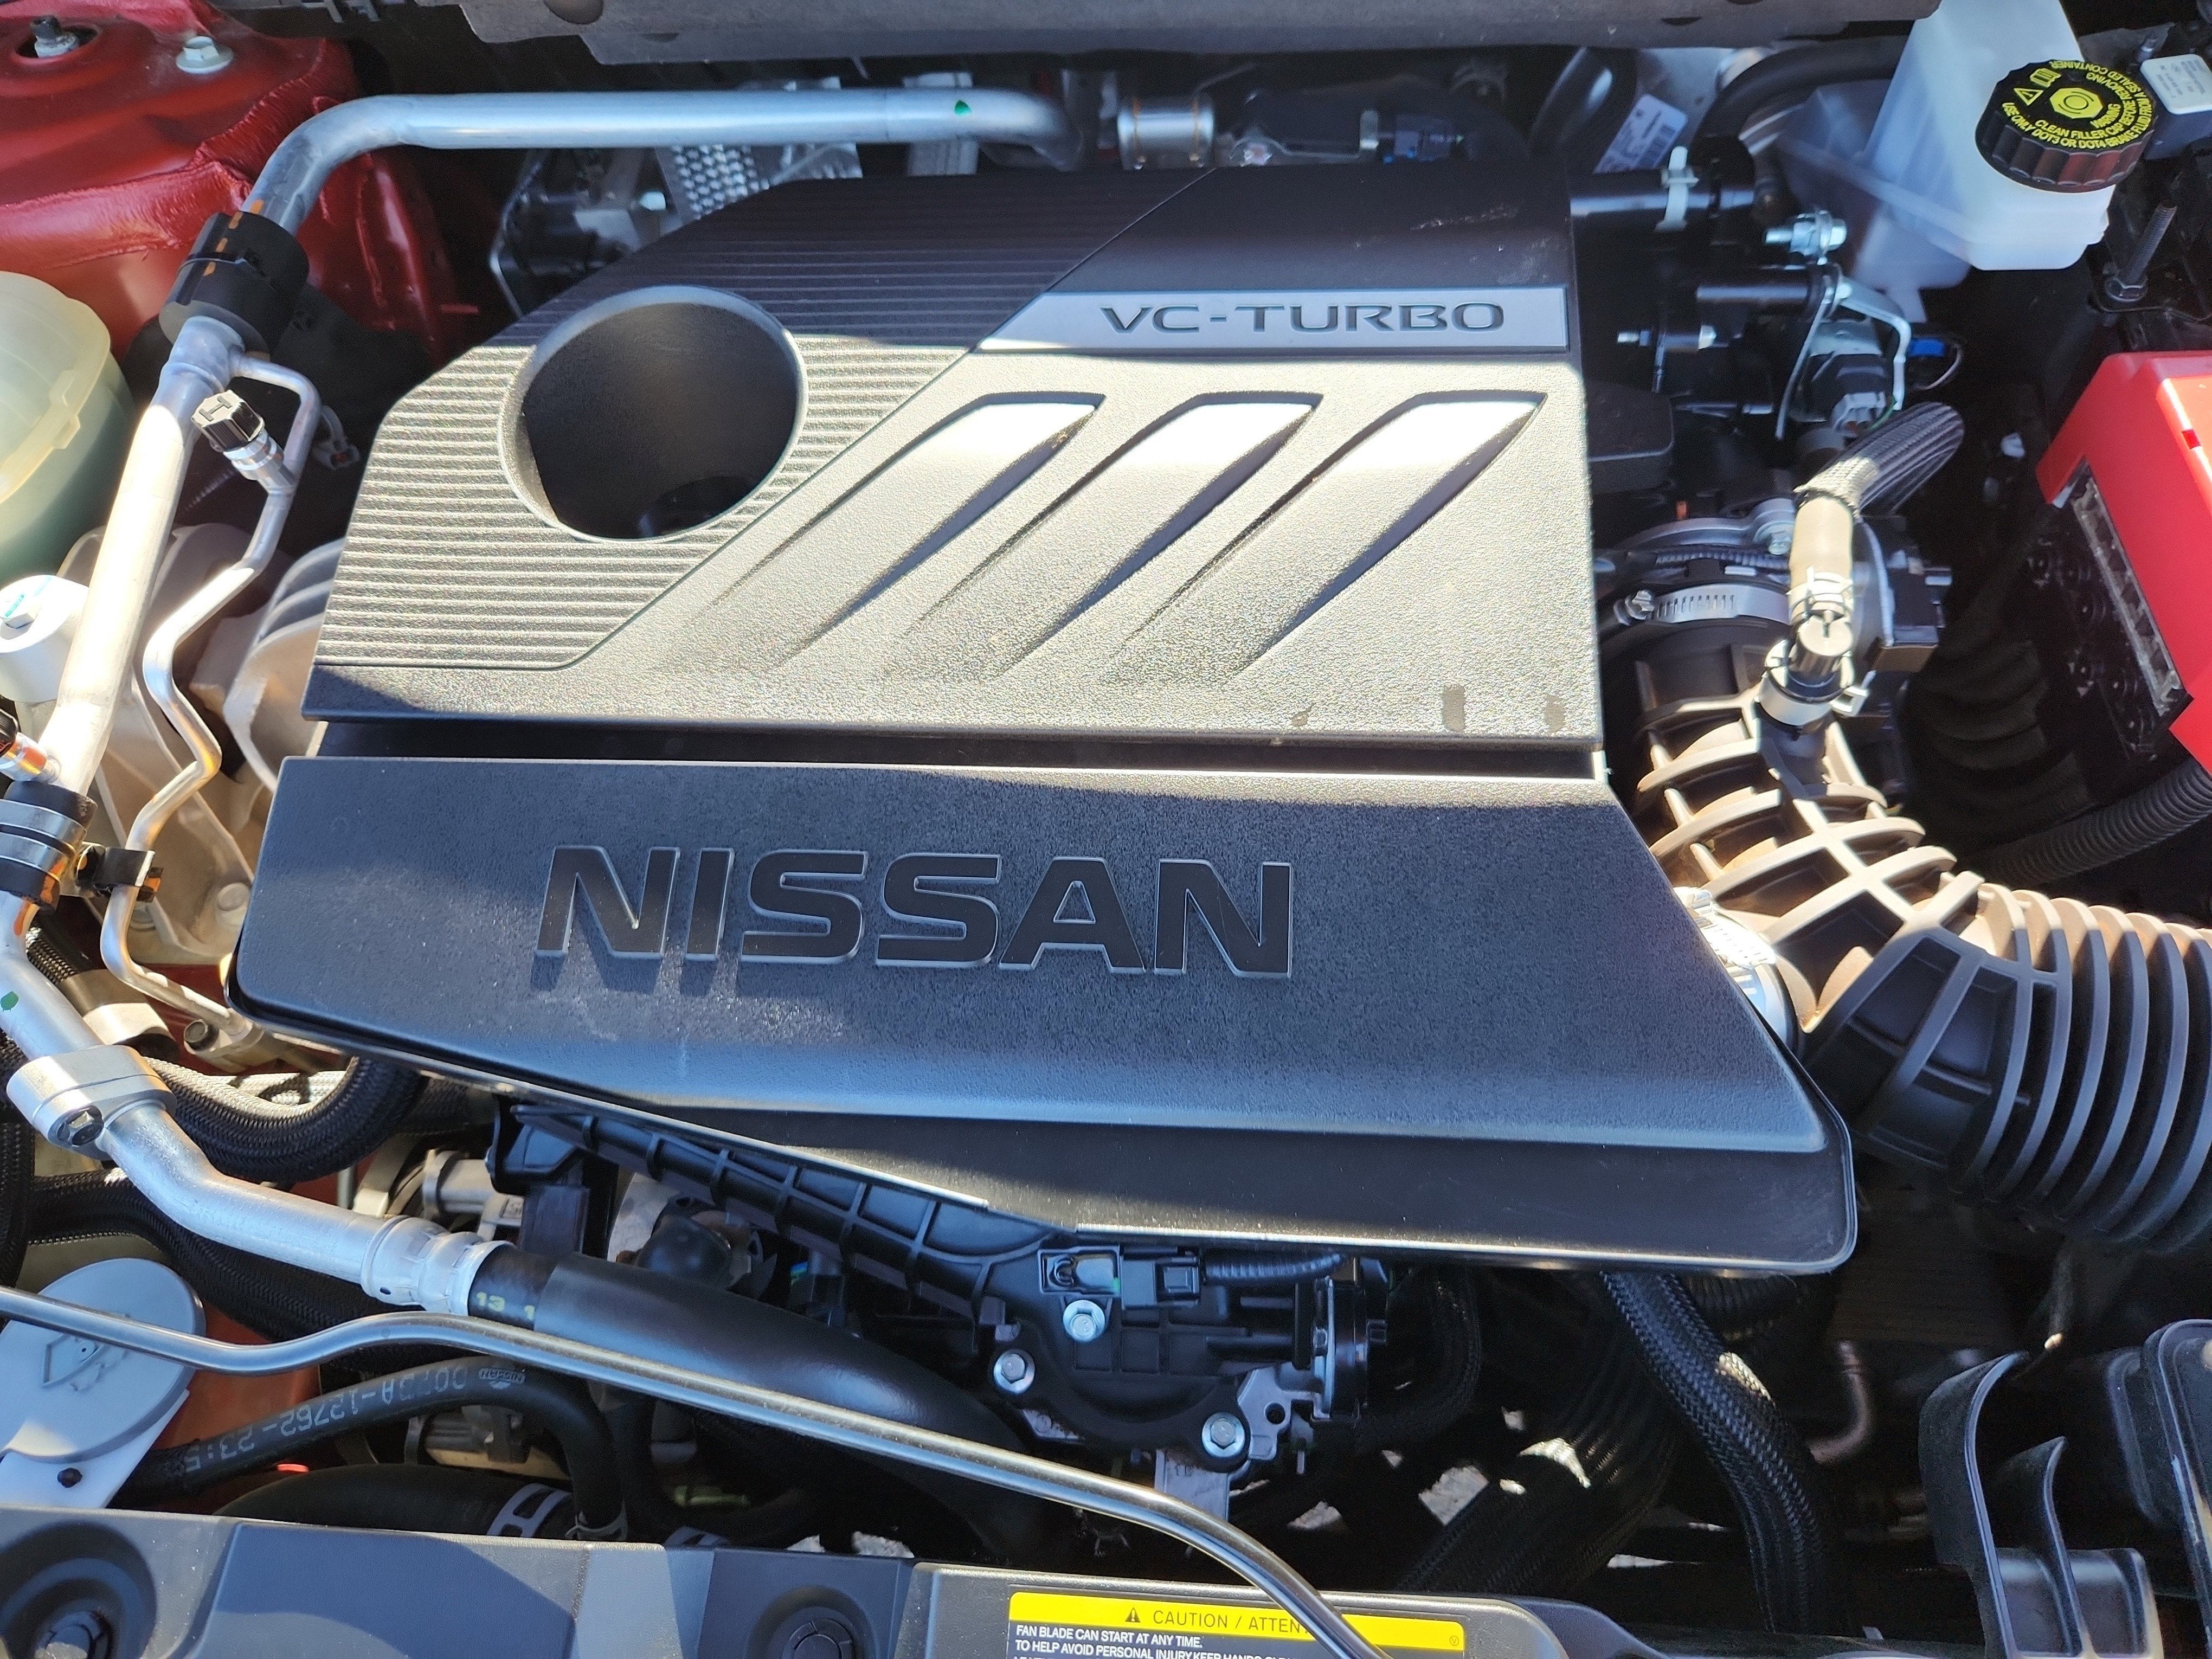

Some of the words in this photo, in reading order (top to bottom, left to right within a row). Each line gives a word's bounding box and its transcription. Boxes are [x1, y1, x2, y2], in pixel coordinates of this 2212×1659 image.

[2049, 61, 2108, 75] CONTAINER
[2086, 72, 2132, 100] REMOVING
[2107, 71, 2142, 93] SEALED
[2090, 104, 2121, 128] WARNING
[2118, 100, 2137, 126] BEFORE
[2137, 98, 2152, 117] FROM
[2011, 115, 2036, 132] ONLY
[2035, 120, 2070, 137] CLEAN
[2105, 122, 2124, 135] CAP
[2130, 115, 2151, 134] FLUID
[2031, 128, 2061, 144] DOT3
[2060, 138, 2077, 148] OR
[2070, 130, 2108, 139] FILLER
[2105, 130, 2139, 147] BRAKE
[2078, 140, 2107, 149] DOT4
[1100, 301, 1505, 333] VC-TURBO
[533, 844, 1292, 978] NISSAN
[1153, 1610, 1227, 1628] CAUTION
[1235, 1615, 1242, 1629] /
[1248, 1617, 1307, 1634] ATTEN
[1017, 1625, 1037, 1637] FAN
[1039, 1626, 1073, 1639] BLADE
[1075, 1629, 1099, 1641] CAN
[1101, 1630, 1135, 1643] START
[1135, 1632, 1150, 1644] AT
[1150, 1634, 1175, 1647] ANY
[1175, 1636, 1203, 1648] TIME.
[1015, 1639, 1030, 1651] TO
[1031, 1641, 1060, 1653] HELP
[1060, 1642, 1095, 1656] AVOID
[1096, 1644, 1154, 1659] PERSONAL
[1155, 1649, 1194, 1659] INJURY
